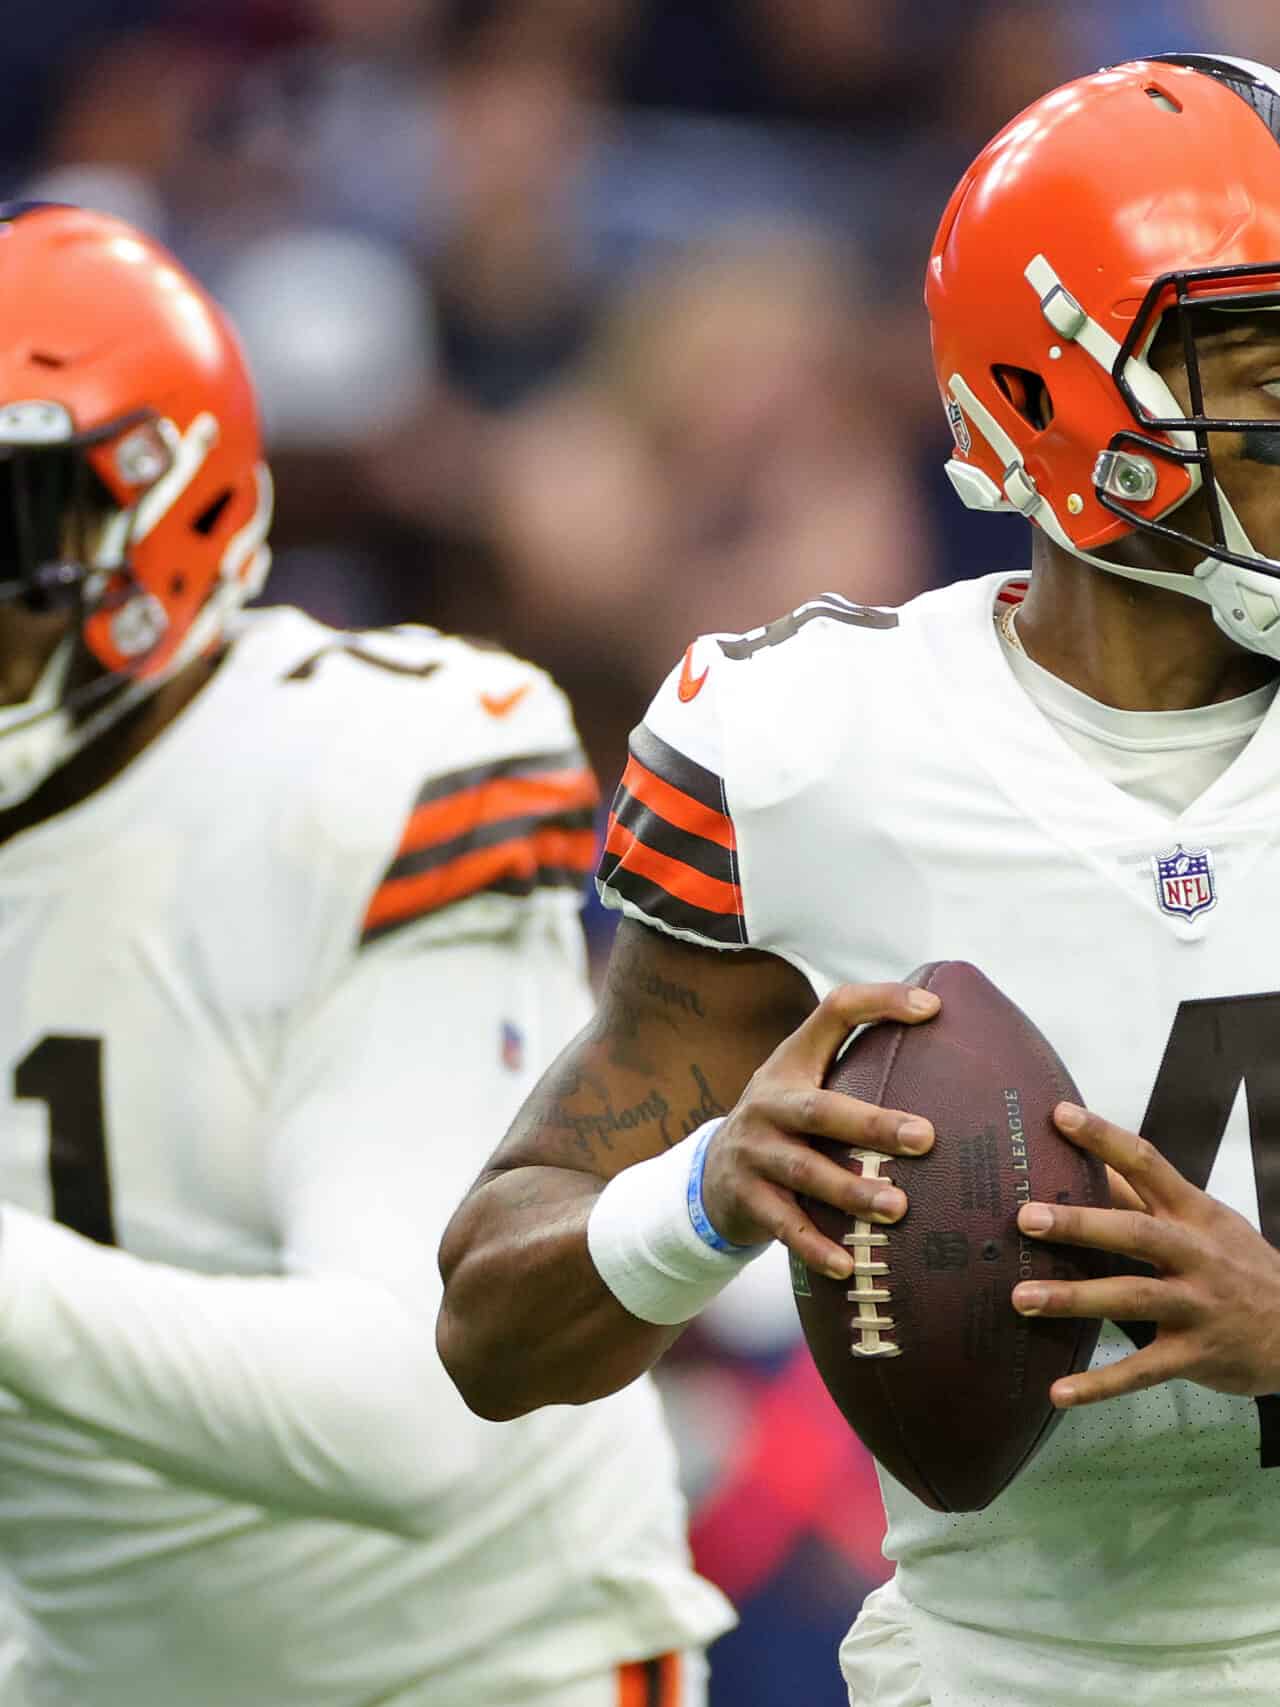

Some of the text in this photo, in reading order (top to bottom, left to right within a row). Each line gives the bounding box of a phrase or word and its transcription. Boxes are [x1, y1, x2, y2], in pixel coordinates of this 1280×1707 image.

[1166, 877, 1208, 908] NFL
[14, 1035, 118, 1247] 1
[1004, 1089, 1029, 1170] LEAGUE
